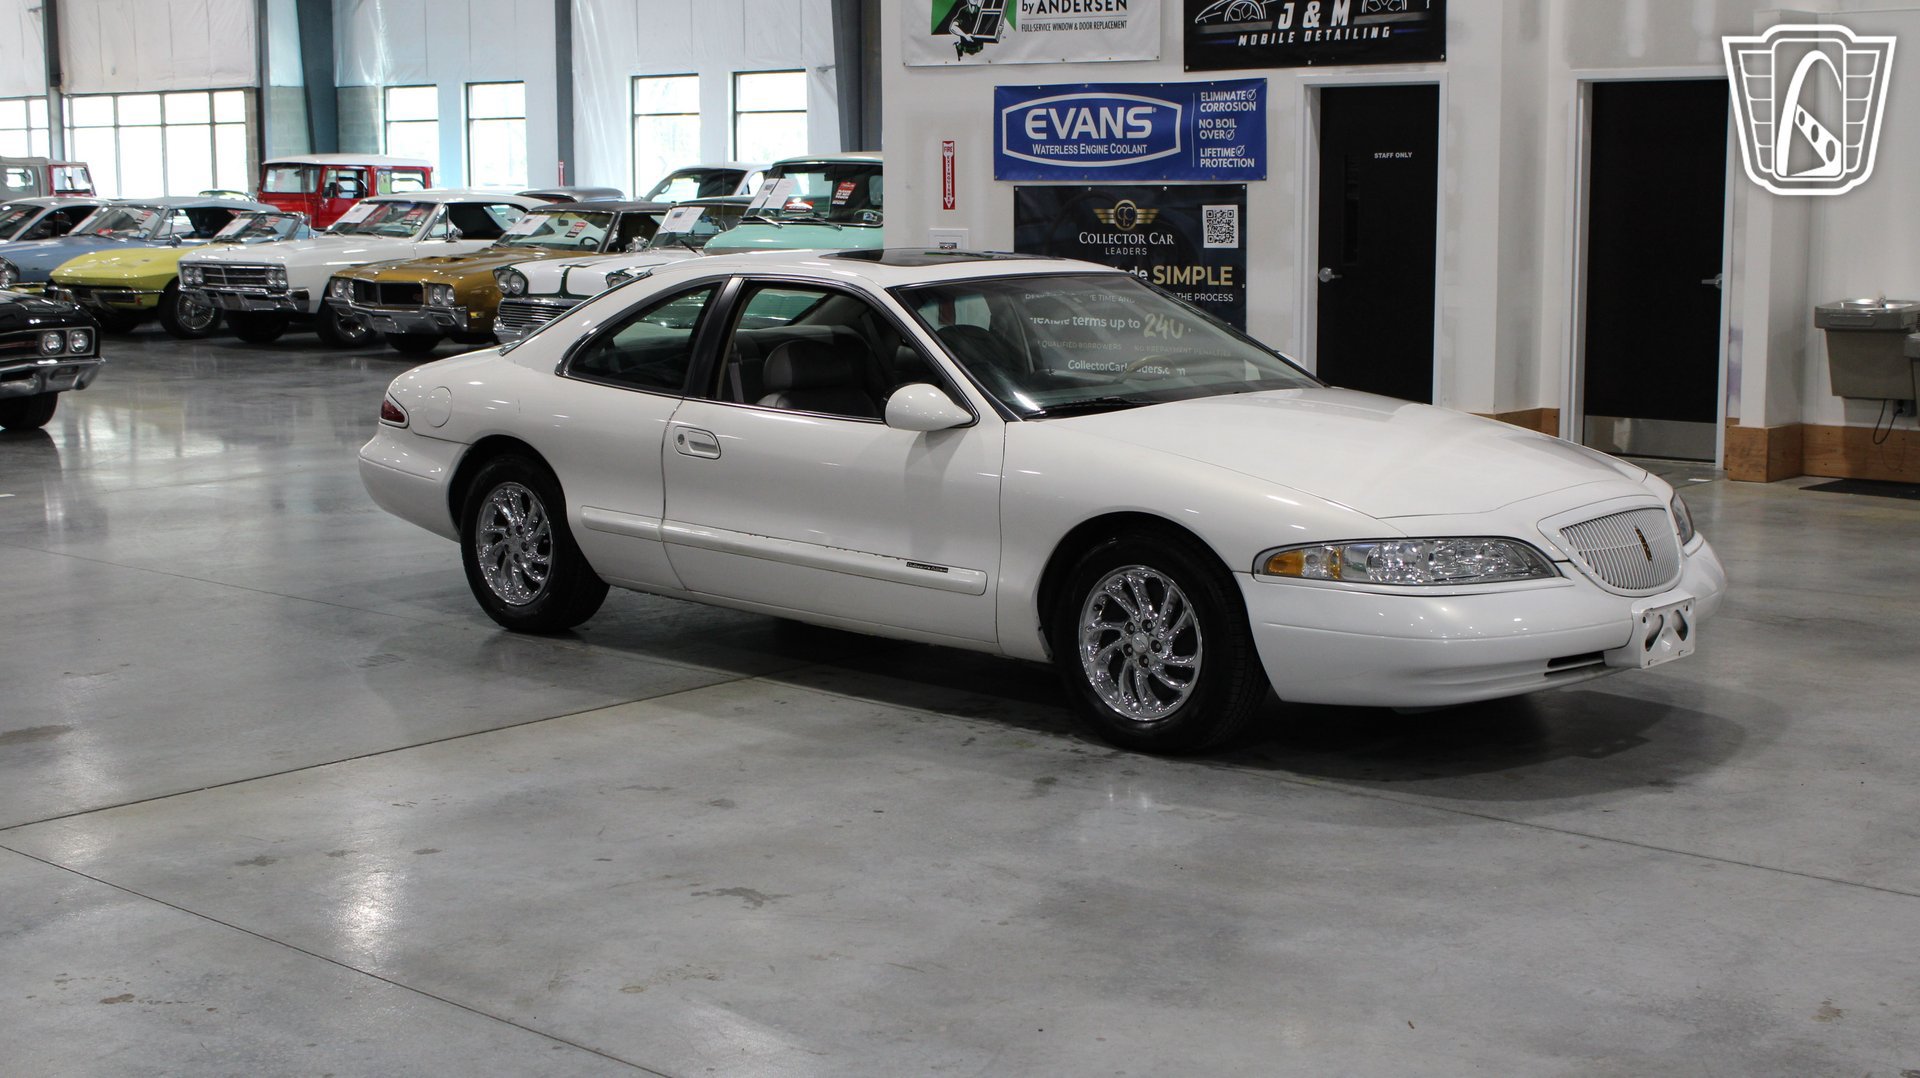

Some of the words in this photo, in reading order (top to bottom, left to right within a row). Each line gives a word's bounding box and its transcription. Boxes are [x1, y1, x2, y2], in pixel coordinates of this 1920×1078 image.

[1022, 0, 1035, 14] by
[1036, 0, 1128, 14] ANDERSEN
[1277, 1, 1294, 30] J
[1302, 1, 1321, 29] &
[1330, 0, 1350, 27] M
[1052, 22, 1074, 31] WINDOW
[1074, 22, 1079, 30] &
[1079, 21, 1093, 31] DOOR
[1093, 20, 1127, 30] REPLACEMENT
[1238, 31, 1295, 46] MOBILE
[1304, 26, 1390, 42] DETAILING
[1200, 90, 1246, 102] ELIMINATE
[1200, 101, 1257, 112] CORROSION
[1199, 119, 1214, 128] NO
[1215, 118, 1237, 128] BOIL
[1200, 130, 1225, 139] OVER
[1200, 147, 1236, 157] LIFETIME
[1395, 151, 1413, 159] ONLY
[1200, 158, 1255, 168] PROTECTION
[1149, 232, 1175, 245] CAR
[1105, 247, 1148, 255] LEADERS
[1152, 265, 1234, 287] SIMPLE
[1194, 292, 1234, 302] PROCESS
[1072, 316, 1108, 328] terms
[1109, 318, 1126, 331] up
[1128, 318, 1141, 329] to
